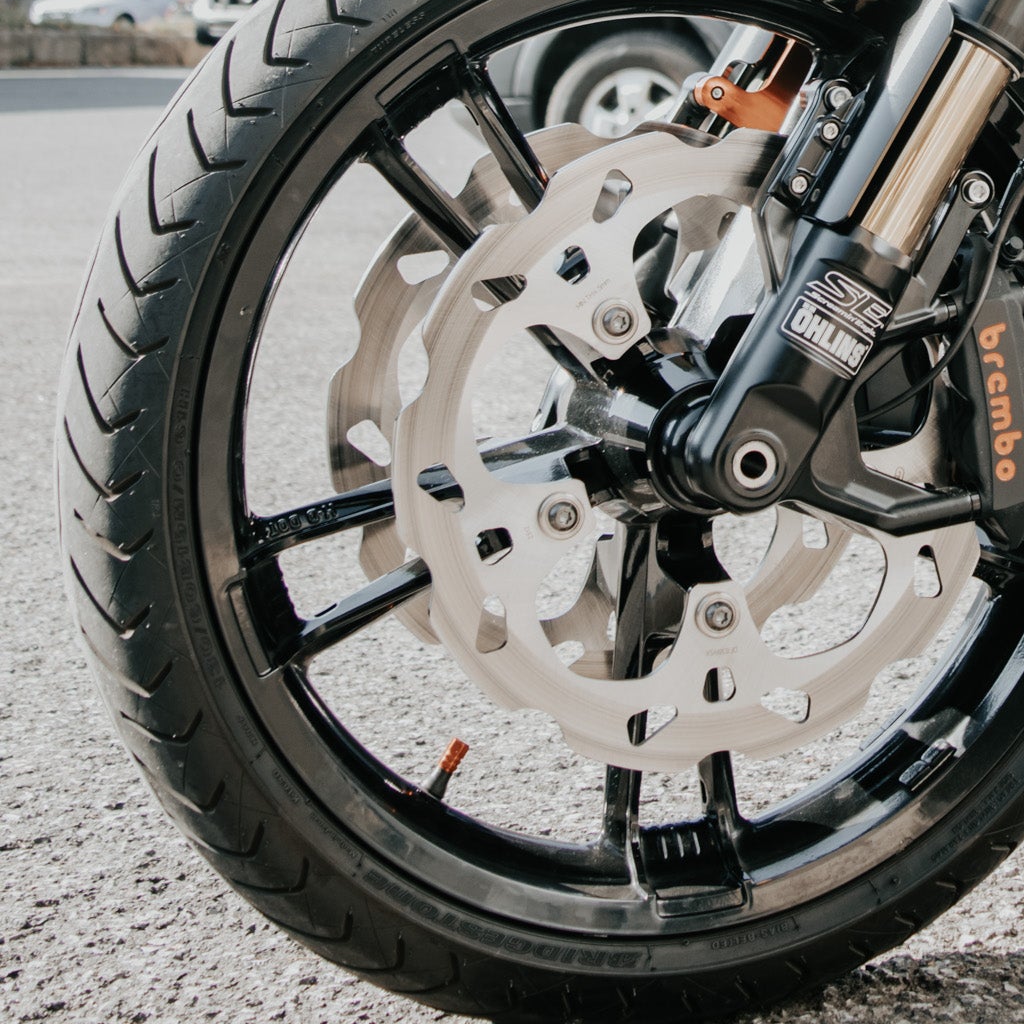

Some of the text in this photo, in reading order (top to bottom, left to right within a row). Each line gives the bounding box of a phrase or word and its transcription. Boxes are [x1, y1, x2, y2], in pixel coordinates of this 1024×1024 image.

[789, 301, 869, 368] ÖHLINS
[806, 270, 893, 328] SE
[978, 322, 1022, 482] brembo
[360, 864, 642, 969] BRIDGESTONE
